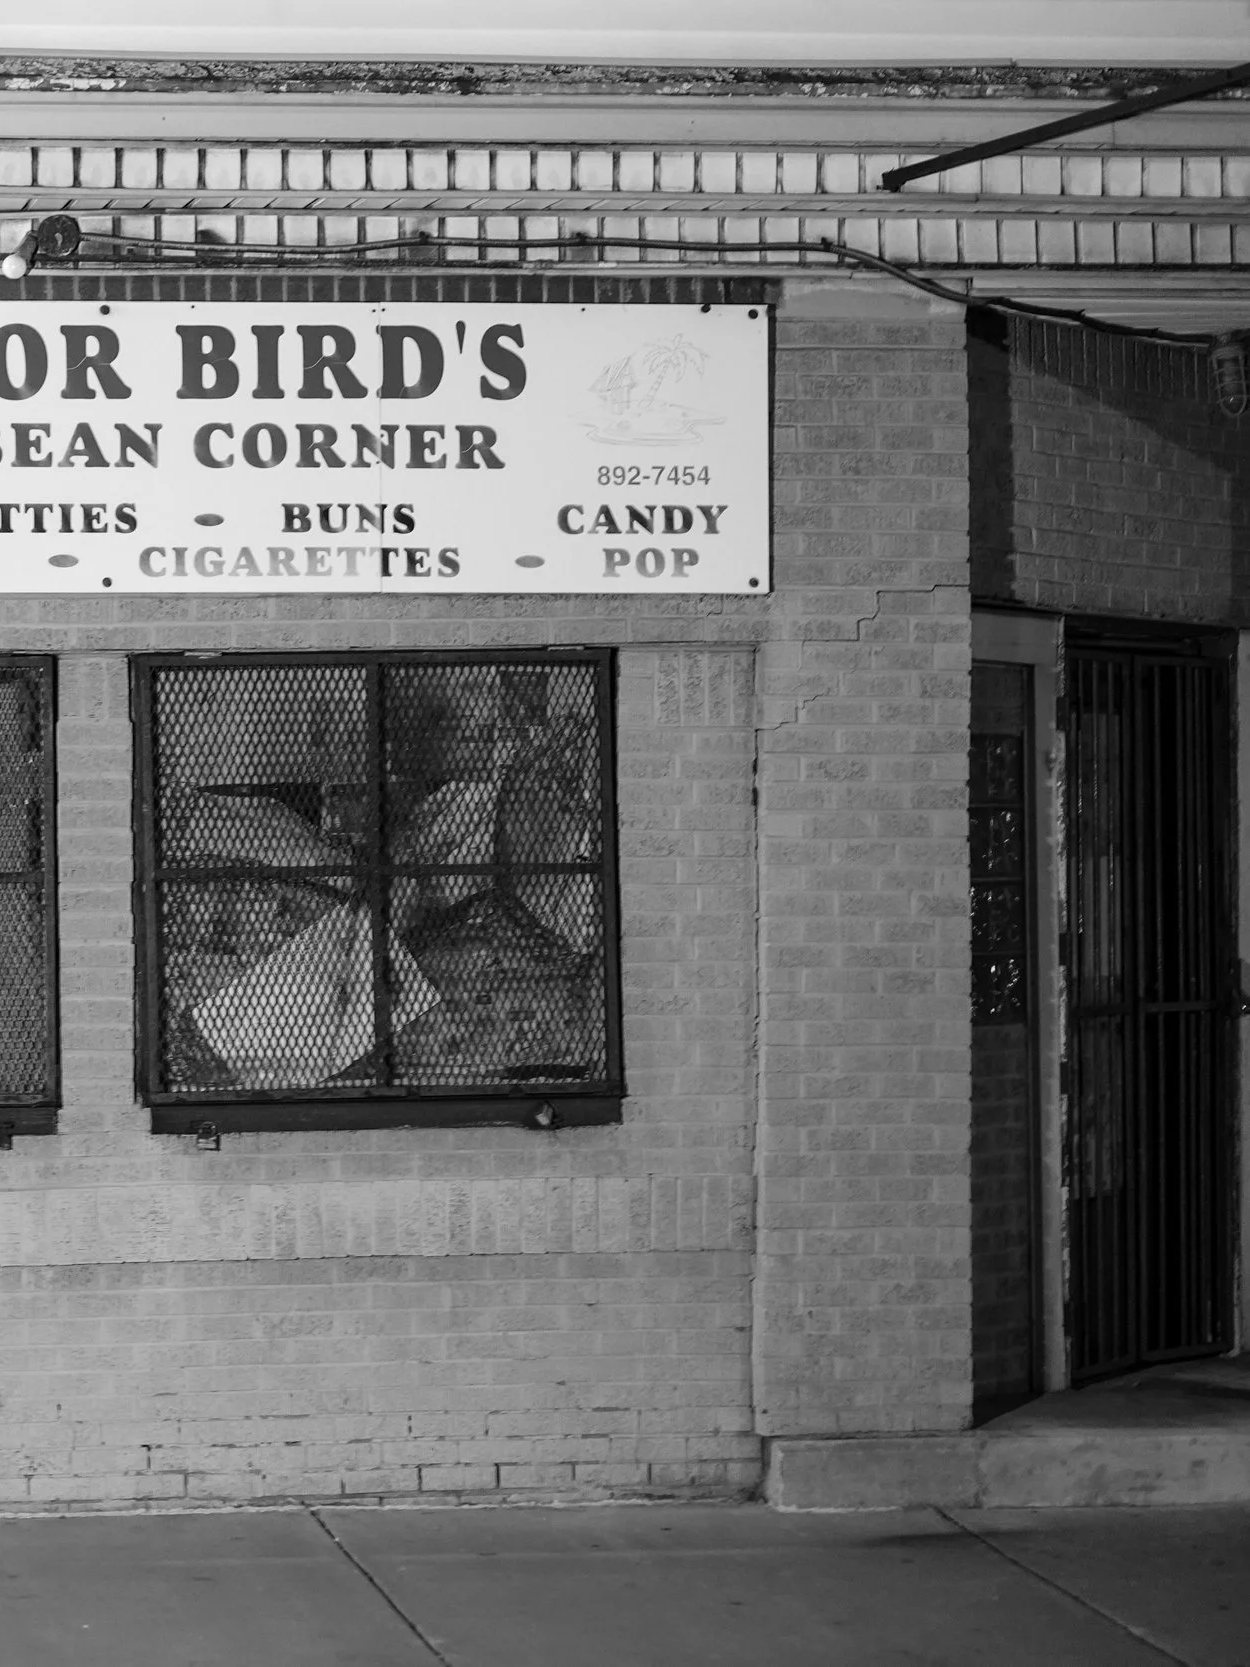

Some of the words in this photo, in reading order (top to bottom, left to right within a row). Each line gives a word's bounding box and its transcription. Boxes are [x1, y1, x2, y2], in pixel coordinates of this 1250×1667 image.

[176, 320, 527, 400] BIRD'S
[194, 423, 505, 469] CORNER
[598, 466, 710, 485] 892-7454
[282, 504, 415, 534] BUNS
[558, 505, 728, 534] CANDY
[140, 547, 460, 578] CIGARETTES
[603, 548, 699, 577] POP
